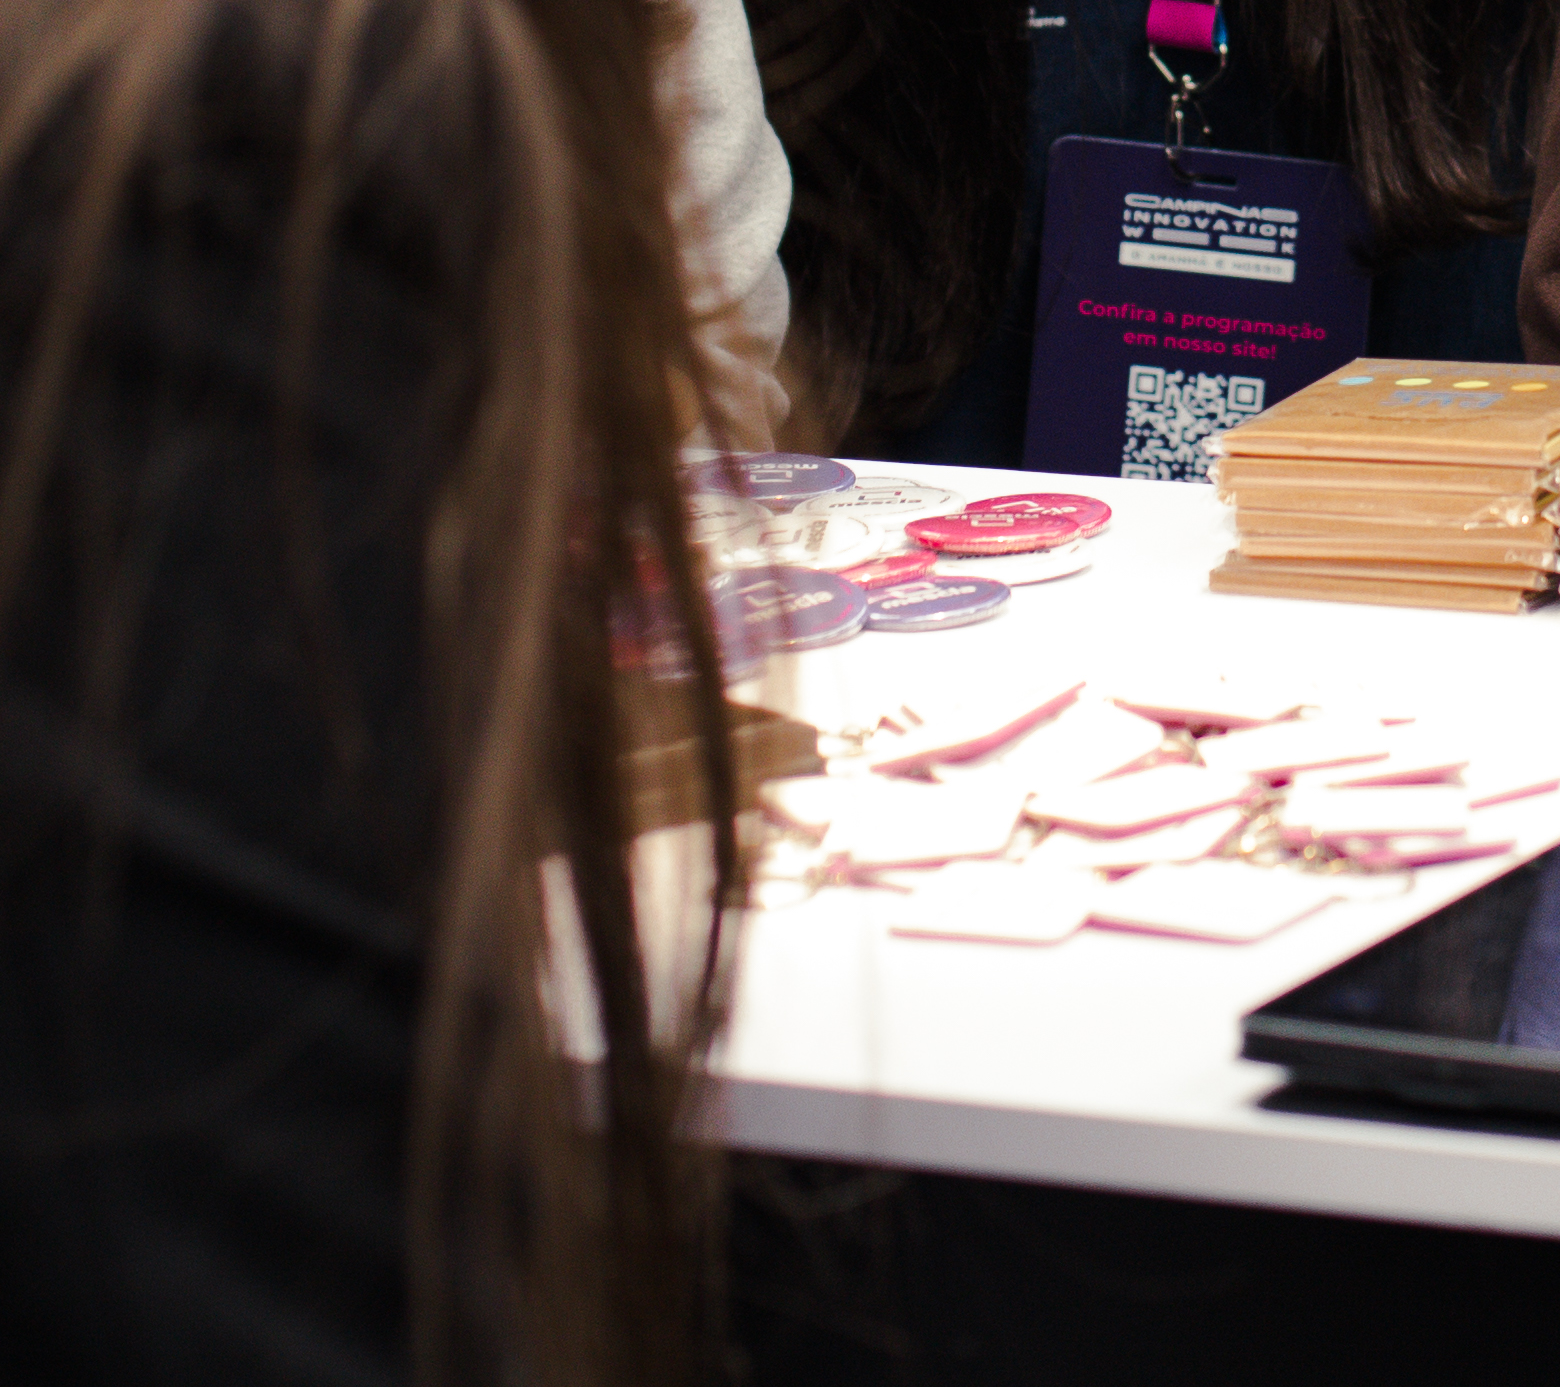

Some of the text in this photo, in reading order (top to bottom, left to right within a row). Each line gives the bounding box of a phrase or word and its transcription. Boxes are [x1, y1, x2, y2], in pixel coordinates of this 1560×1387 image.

[1123, 209, 1298, 239] INNOVATION
[1078, 299, 1327, 342] Confira a programação
[1123, 331, 1277, 359] em nosso site!
